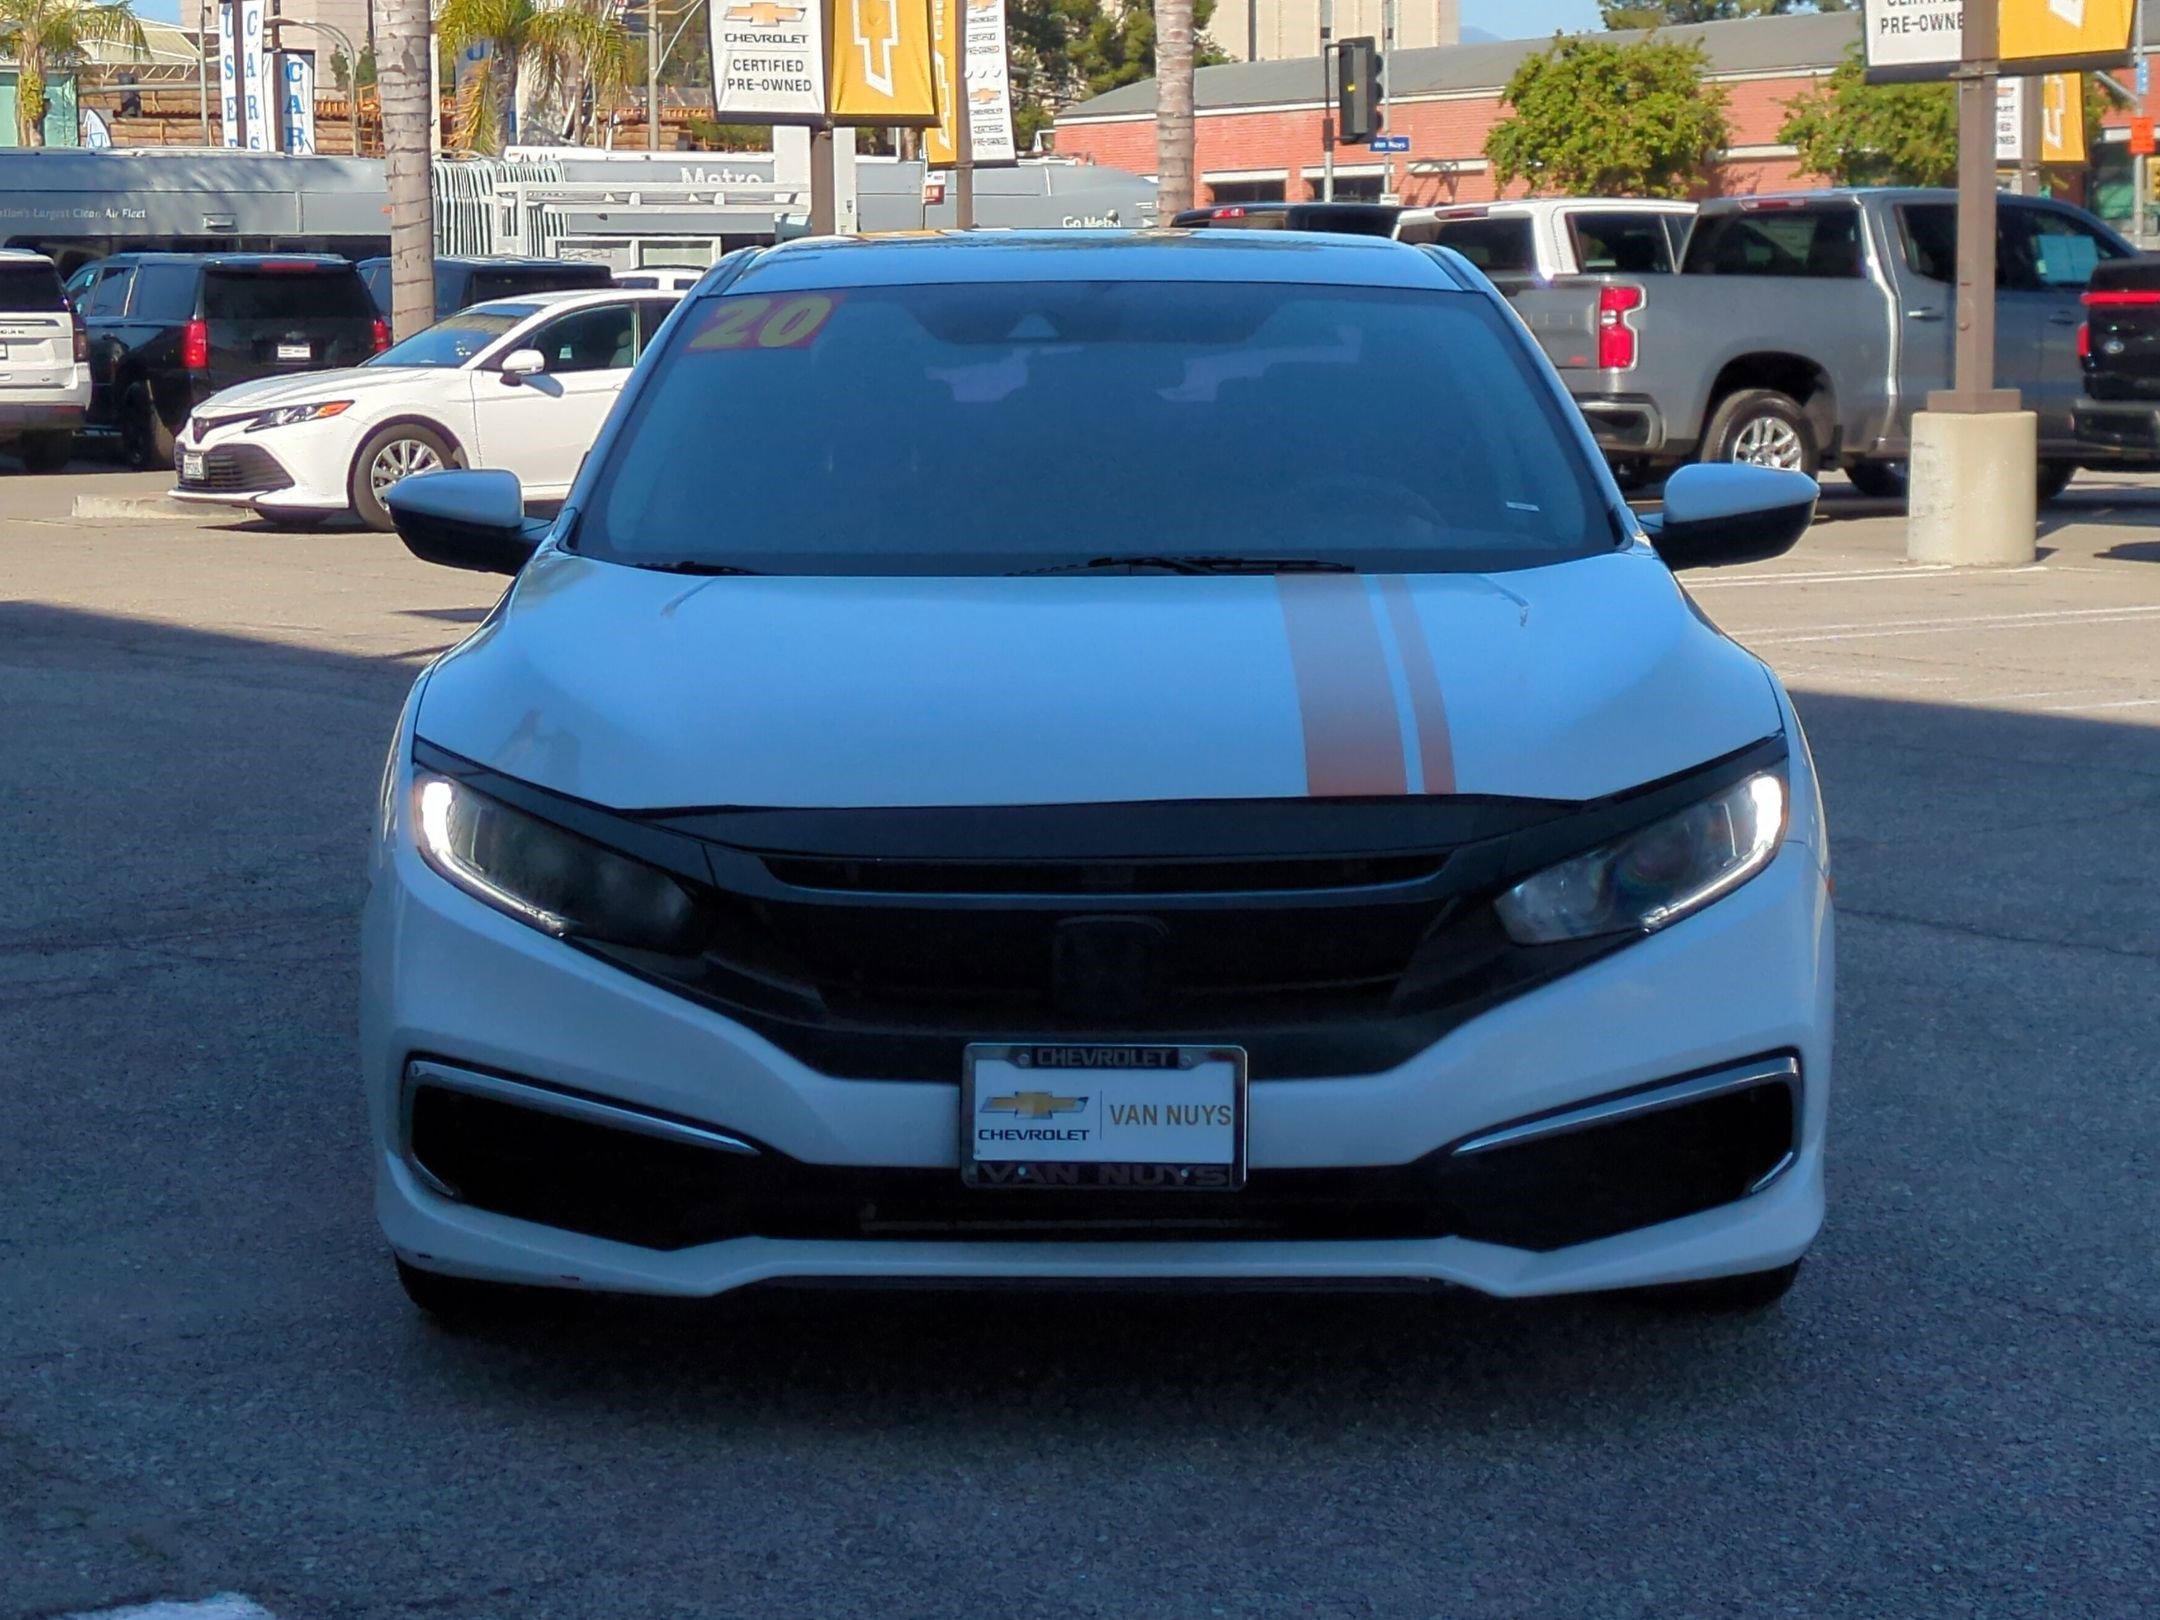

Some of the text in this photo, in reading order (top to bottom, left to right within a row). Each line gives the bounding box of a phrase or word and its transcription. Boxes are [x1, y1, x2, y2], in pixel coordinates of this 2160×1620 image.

[1881, 12, 1963, 34] PRE-OWNE
[725, 33, 808, 44] CHEVROLET
[733, 59, 804, 72] CERTIFIED
[727, 78, 812, 92] PRE-OWNED
[681, 168, 762, 184] Metro
[105, 207, 118, 219] Air
[122, 207, 146, 219] Fleet
[1063, 216, 1082, 228] Go
[689, 295, 832, 348] 20
[1036, 1049, 1171, 1067] CHEVROLET
[1110, 1104, 1232, 1126] VAN NUYS
[978, 1129, 1090, 1141] CHEVROLET
[981, 1163, 1227, 1186] VAN NUYS
